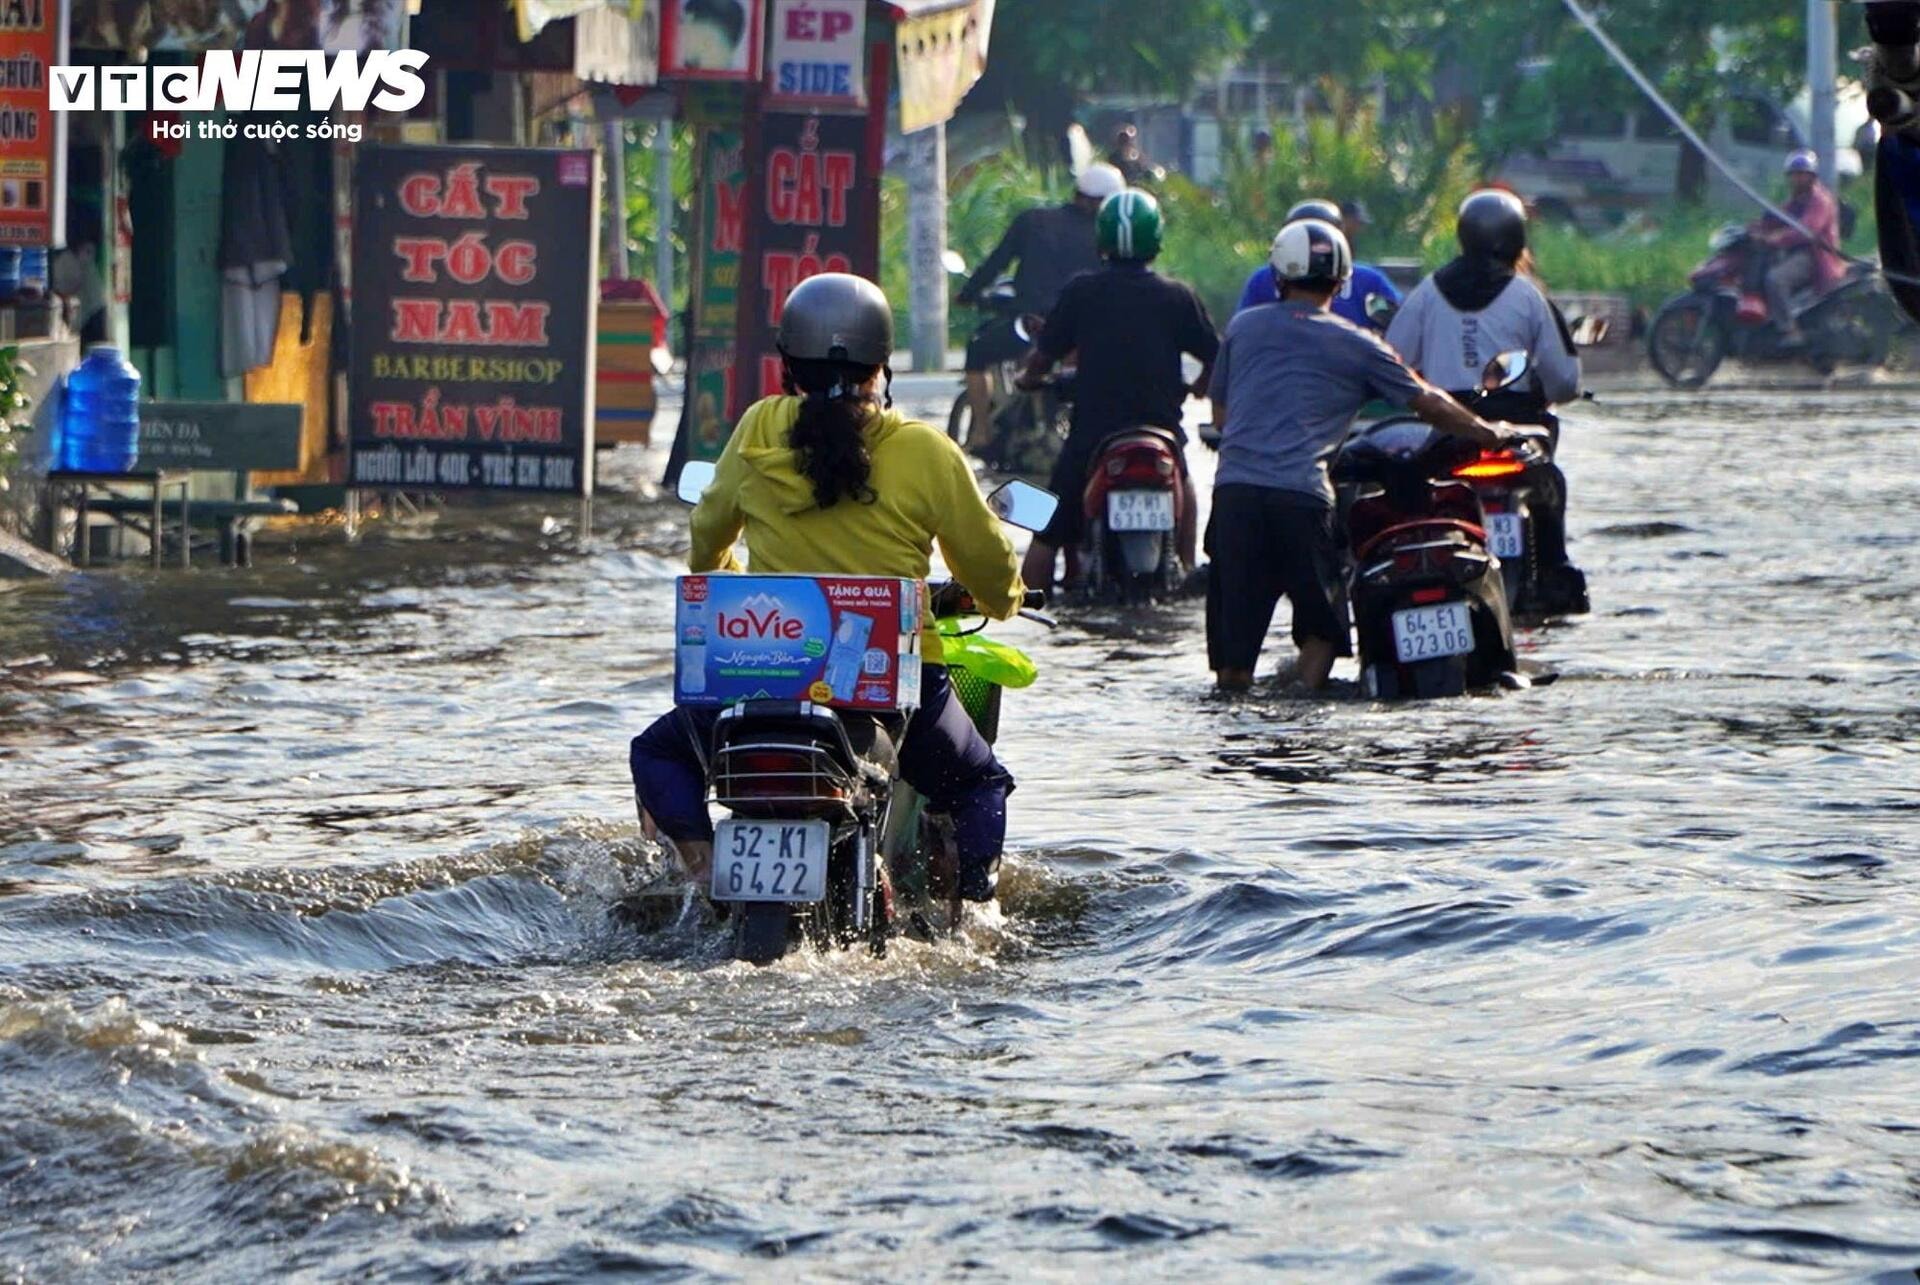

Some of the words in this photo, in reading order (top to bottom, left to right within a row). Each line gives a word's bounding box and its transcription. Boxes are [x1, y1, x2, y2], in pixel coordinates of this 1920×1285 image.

[778, 61, 852, 95] SIDE
[394, 232, 537, 286] TÓC
[390, 299, 551, 347] NAM
[373, 354, 563, 384] BARBERSHOP
[439, 453, 470, 485] 40K
[827, 583, 861, 599] TẶNG
[1405, 607, 1456, 634] 64-E1
[731, 825, 808, 859] 52-K1
[728, 861, 808, 896] 6422
